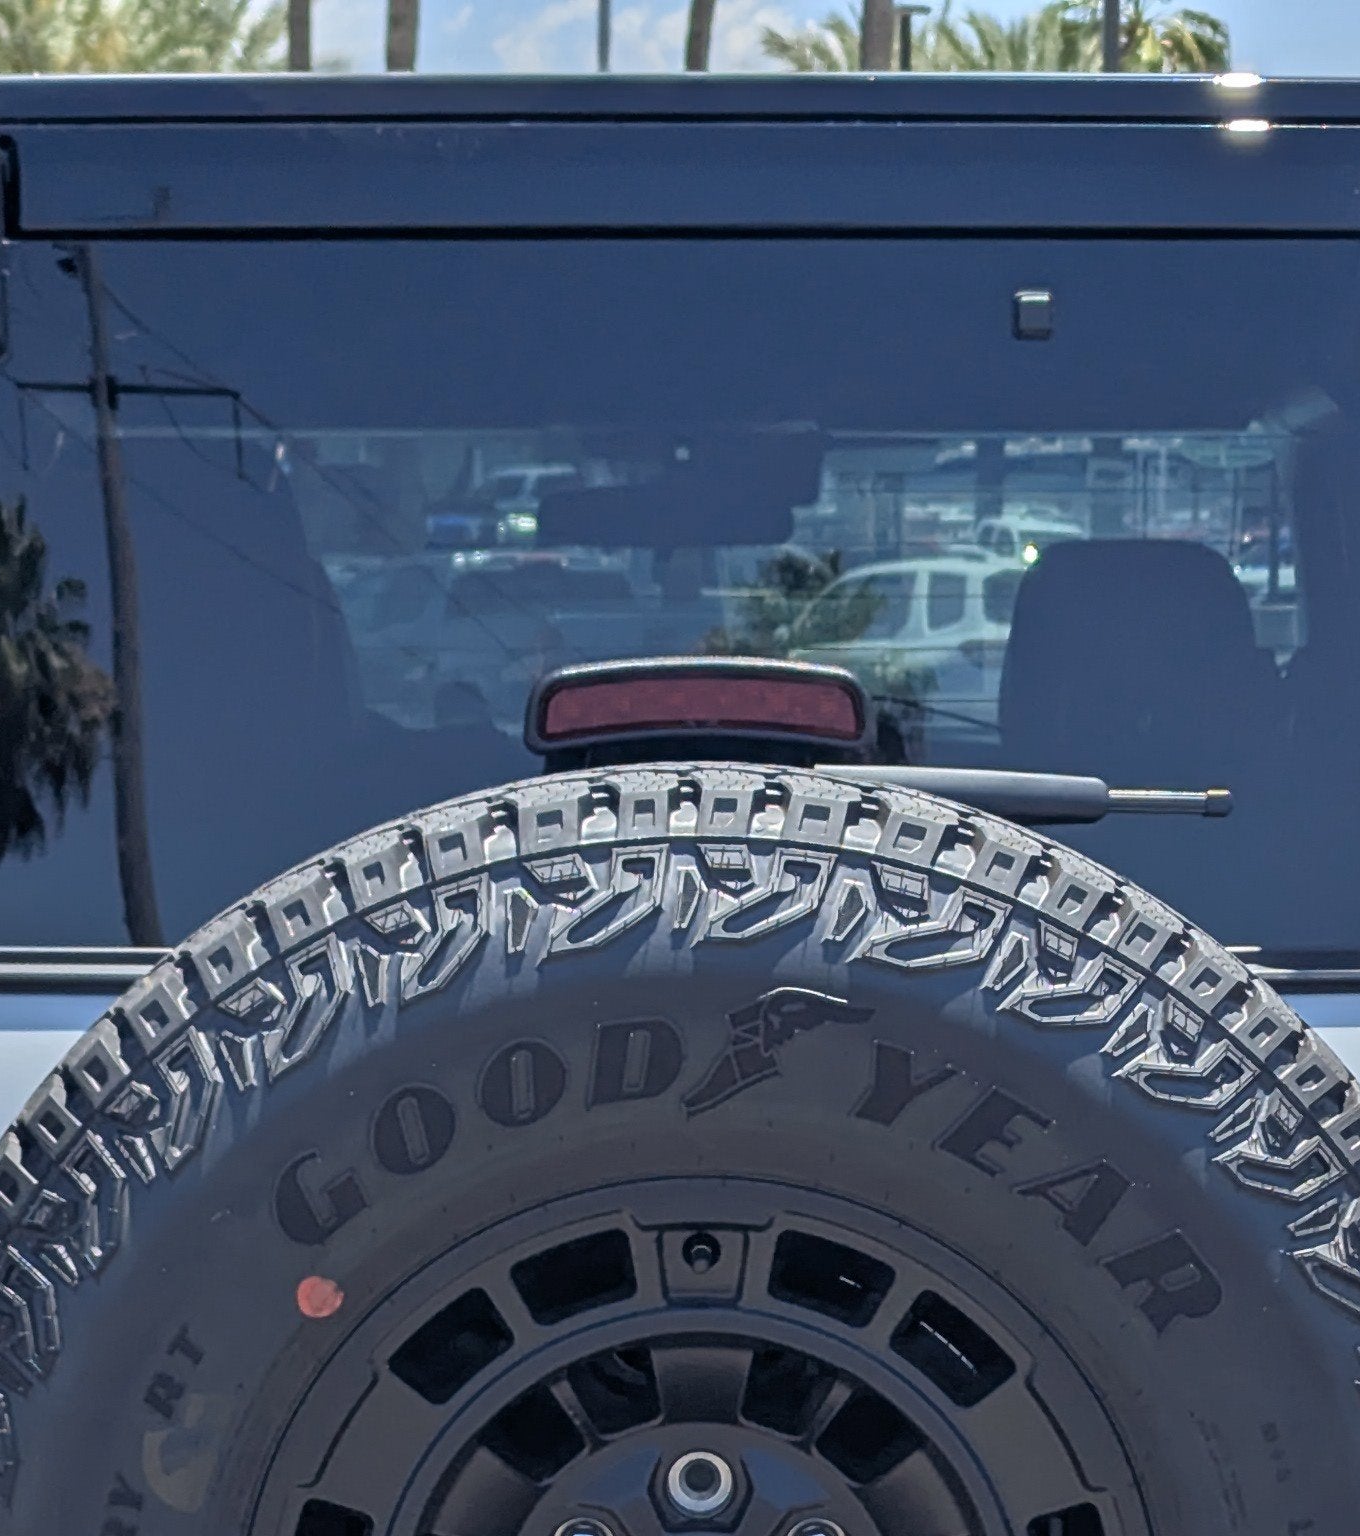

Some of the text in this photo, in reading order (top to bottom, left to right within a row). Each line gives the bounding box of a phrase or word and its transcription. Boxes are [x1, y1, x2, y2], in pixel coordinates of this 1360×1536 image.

[272, 1015, 1223, 1338] GOOD YEAR
[143, 1325, 206, 1420] RT
